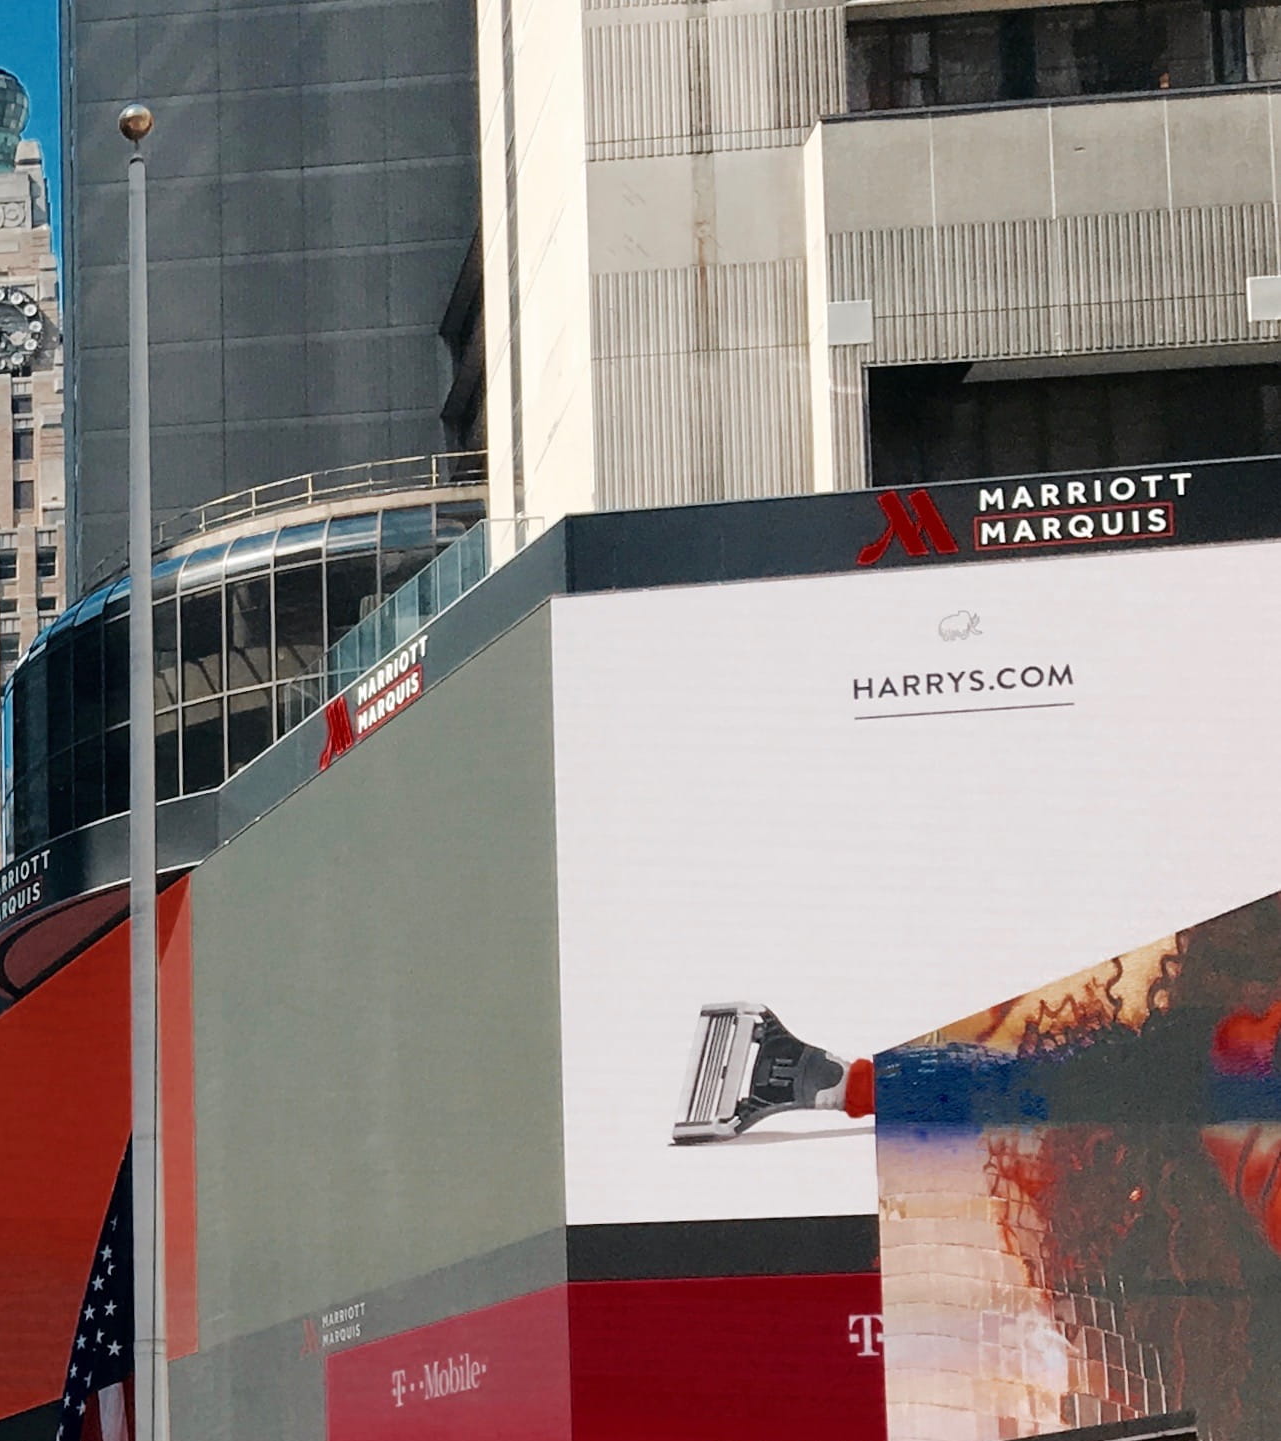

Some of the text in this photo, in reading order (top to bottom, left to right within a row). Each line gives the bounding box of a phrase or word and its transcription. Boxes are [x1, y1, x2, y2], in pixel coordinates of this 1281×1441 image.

[978, 473, 1193, 513] MARRIOTT
[980, 508, 1168, 546] MARQUIS
[356, 635, 428, 702] MARRIOTT
[852, 663, 1074, 701] HARRYS.COM
[356, 670, 420, 735] MARQUIS
[322, 1302, 366, 1328] MARRIOTT
[322, 1323, 361, 1347] MARQUIS
